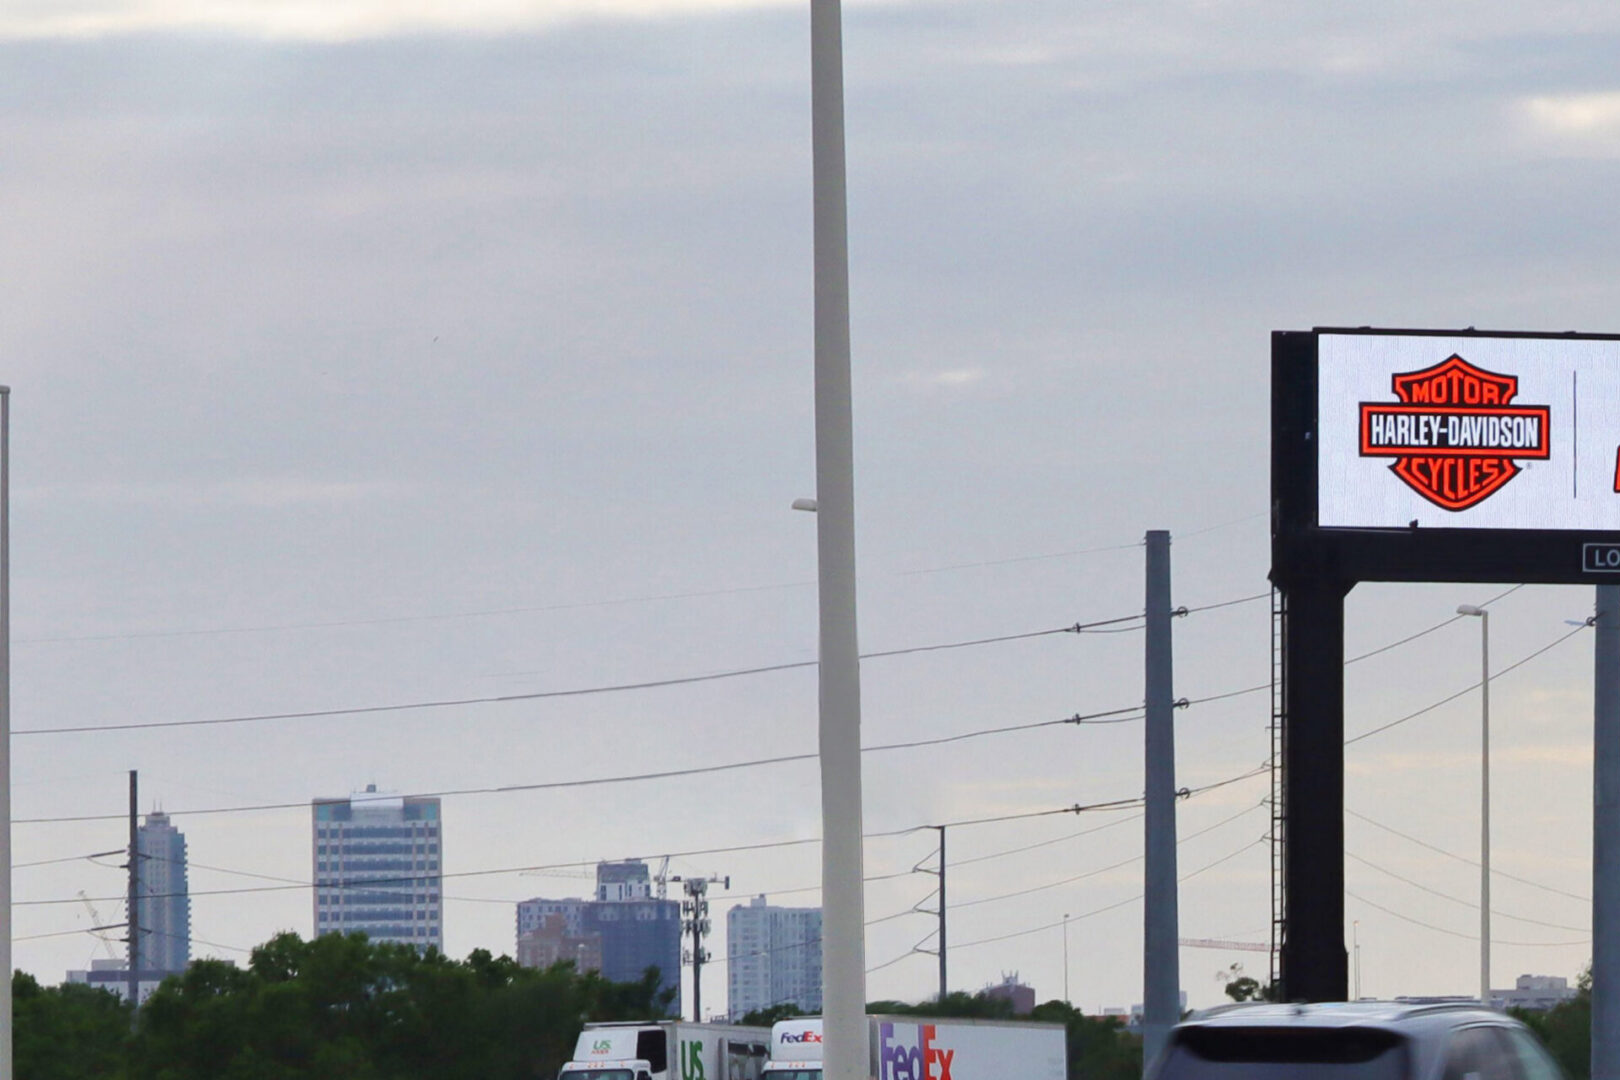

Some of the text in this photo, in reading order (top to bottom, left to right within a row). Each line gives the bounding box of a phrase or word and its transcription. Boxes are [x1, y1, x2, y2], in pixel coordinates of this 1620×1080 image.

[1411, 368, 1500, 405] MOTOR
[1371, 414, 1539, 448] HARLEY-DAVIDSON
[1411, 457, 1499, 500] CYCLES
[780, 1031, 822, 1044] FedEx
